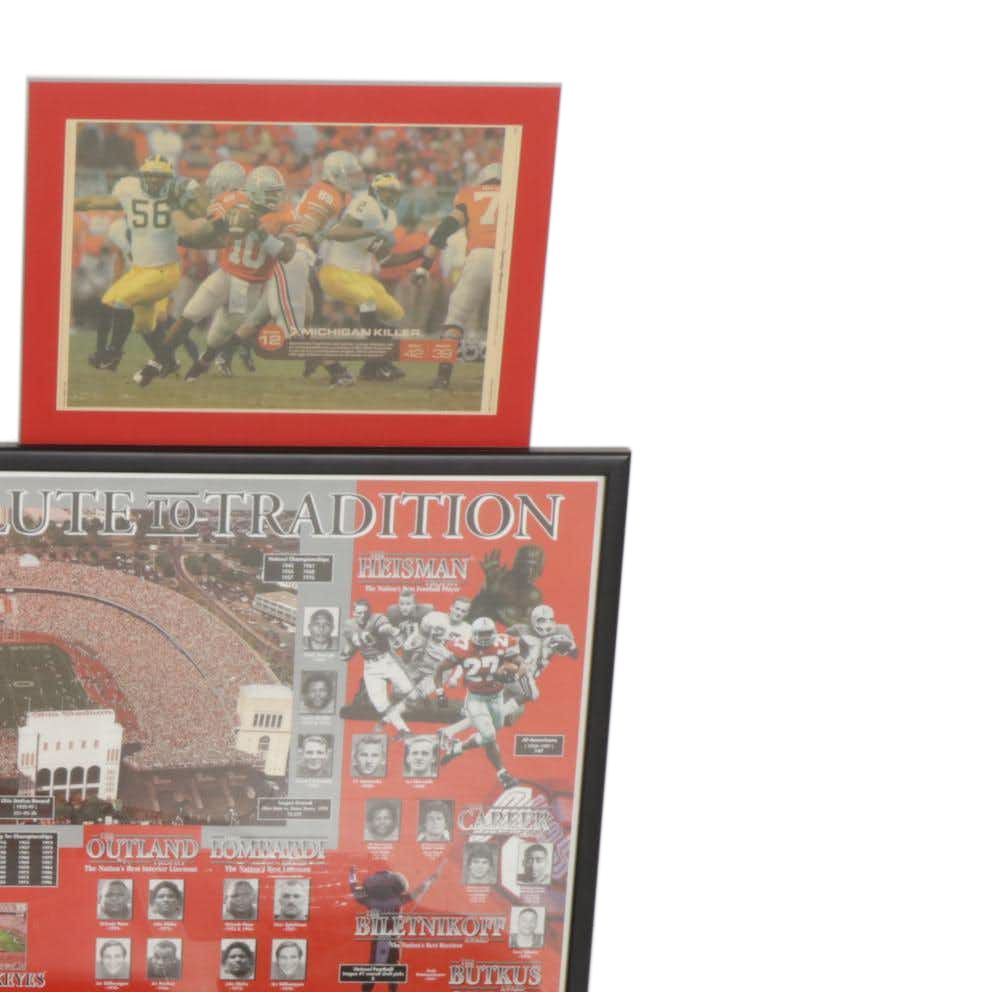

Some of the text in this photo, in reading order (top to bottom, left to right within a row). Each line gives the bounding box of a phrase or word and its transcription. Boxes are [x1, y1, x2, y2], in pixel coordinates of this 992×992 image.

[132, 199, 171, 228] 56
[144, 498, 199, 530] TO
[203, 490, 565, 540] TRADITION
[358, 557, 470, 580] HEISMAN
[463, 655, 499, 682] 27
[86, 838, 202, 861] OUTLAND
[354, 915, 507, 937] BILETNIKOFF
[448, 964, 543, 986] BUTKUS
